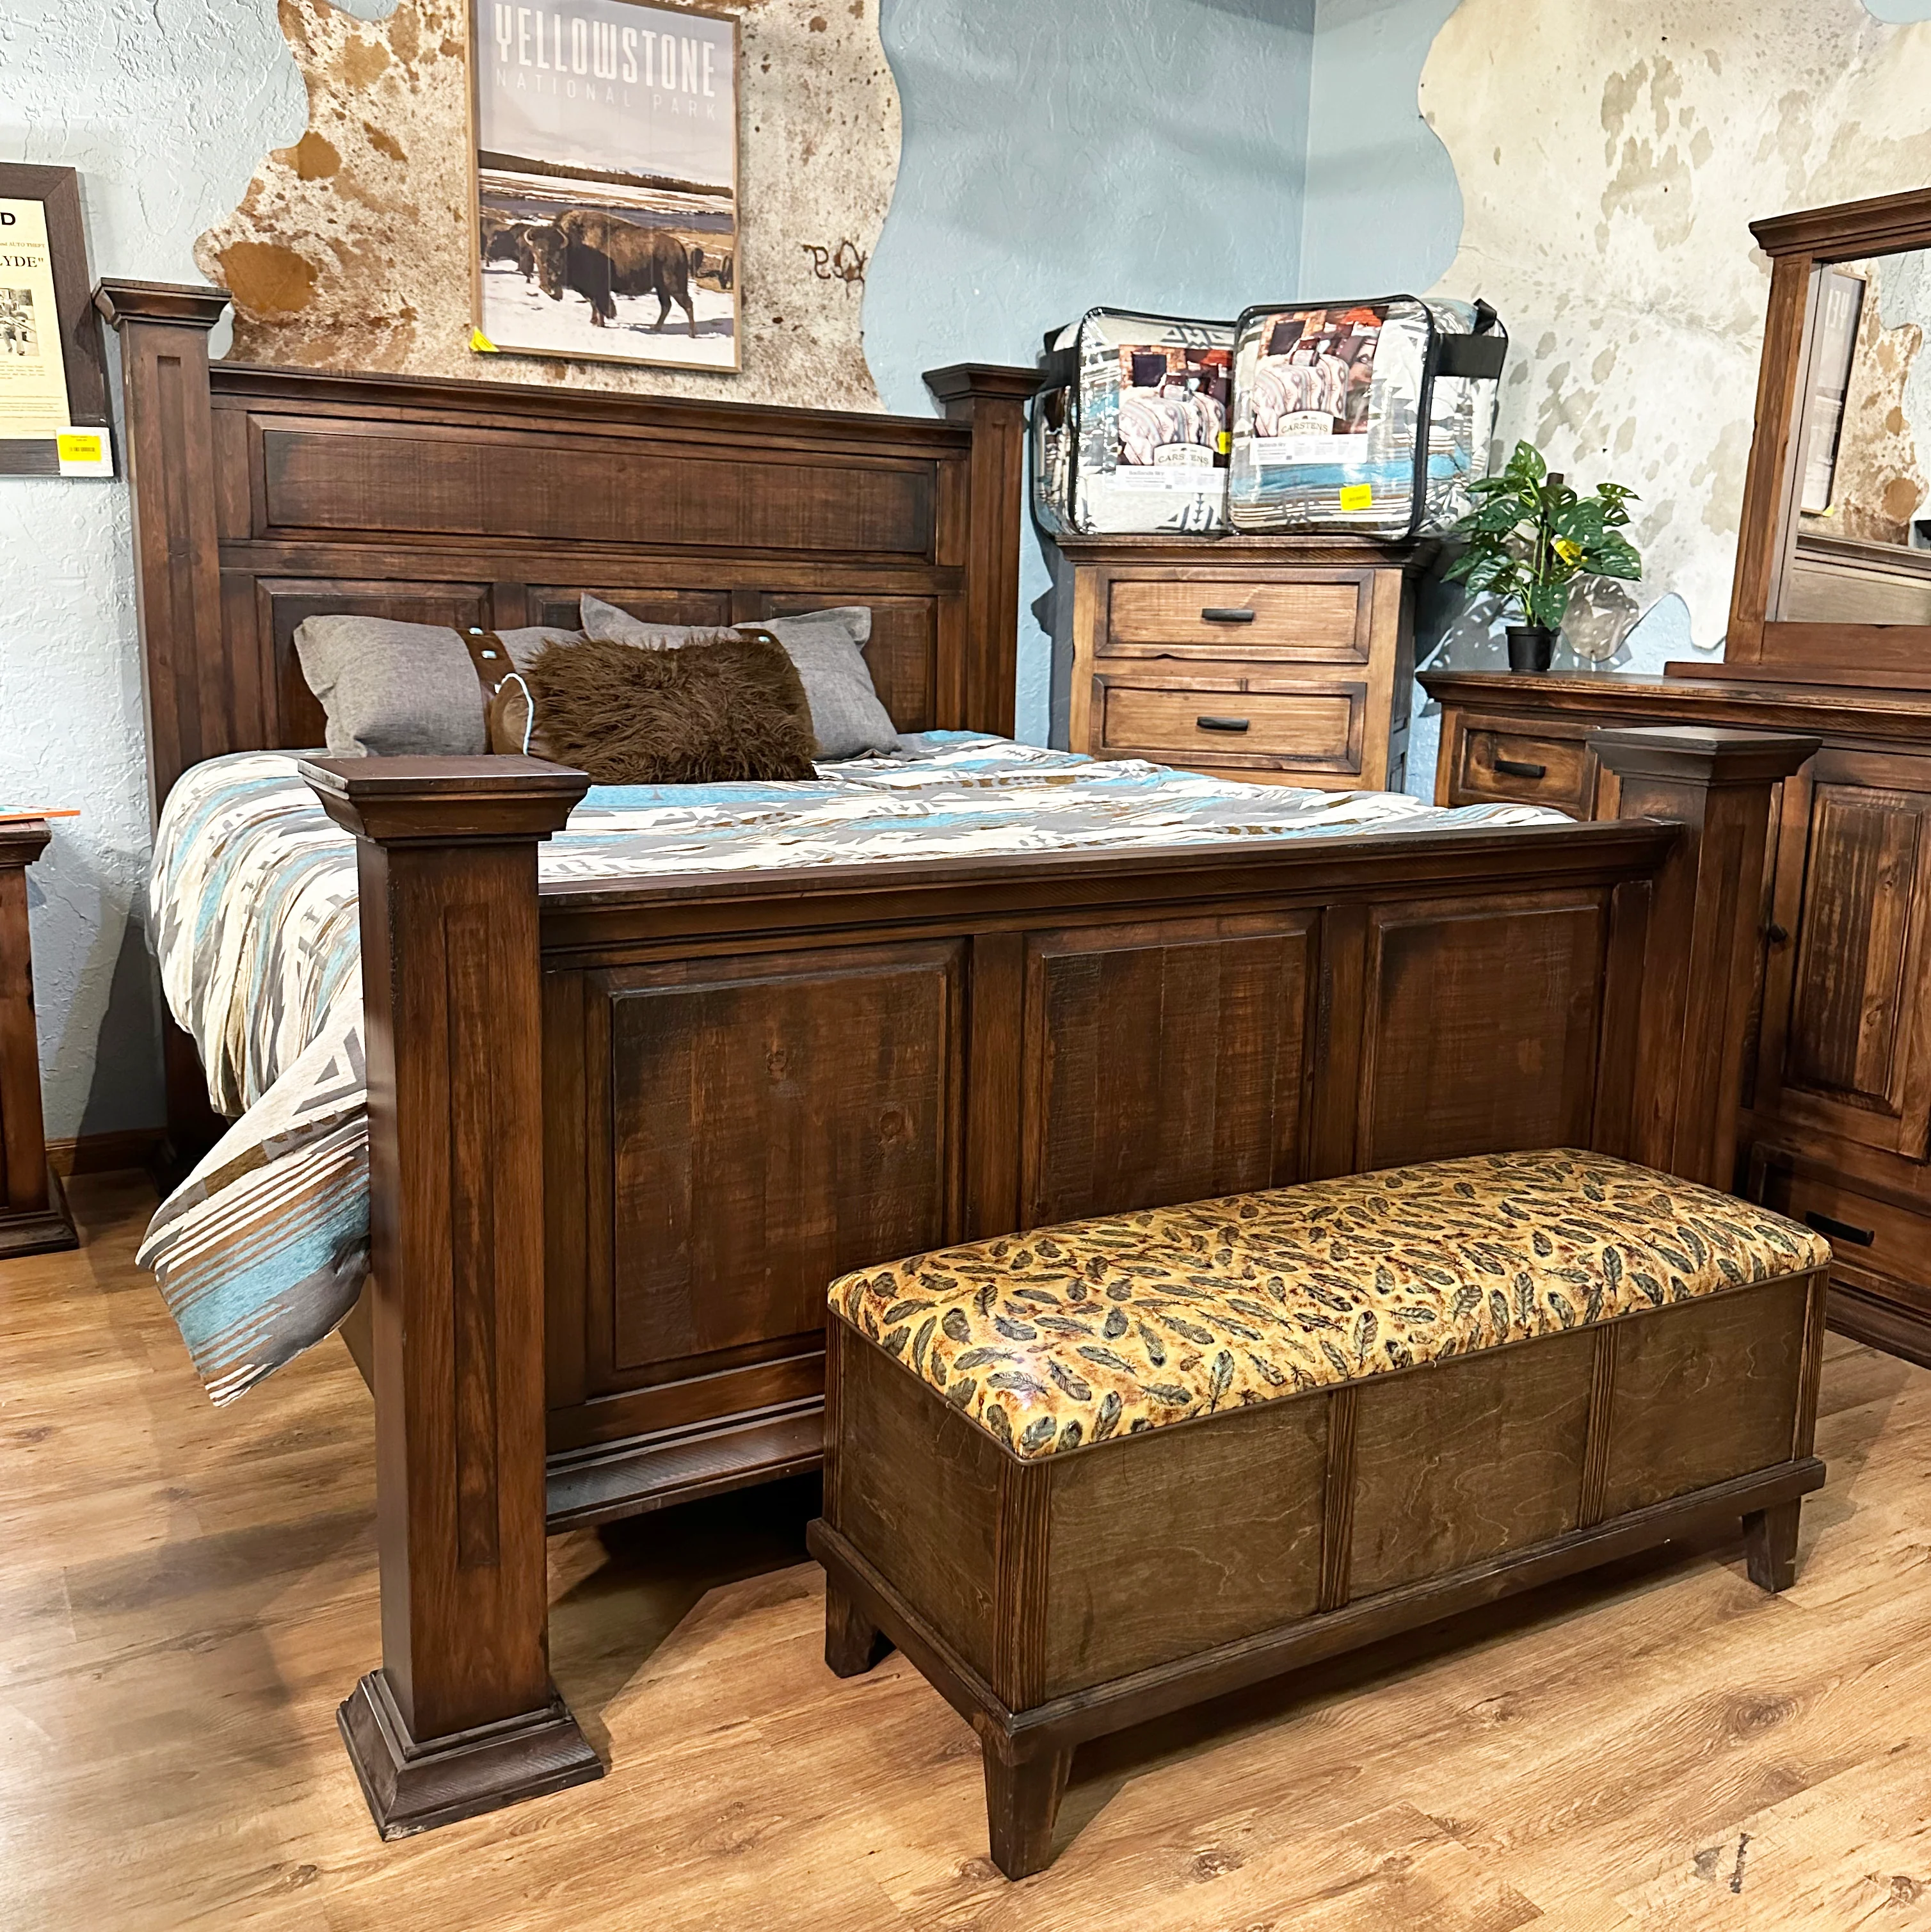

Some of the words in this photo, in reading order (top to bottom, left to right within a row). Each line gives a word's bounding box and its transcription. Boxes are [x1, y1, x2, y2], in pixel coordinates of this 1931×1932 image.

[495, 3, 716, 97] YELLOWSTONE
[495, 68, 632, 108] NATIONAL
[653, 94, 717, 121] PARK
[0, 255, 44, 268] YDE"
[1281, 422, 1329, 434] CARSTENS
[1158, 453, 1210, 465] CARSENS
